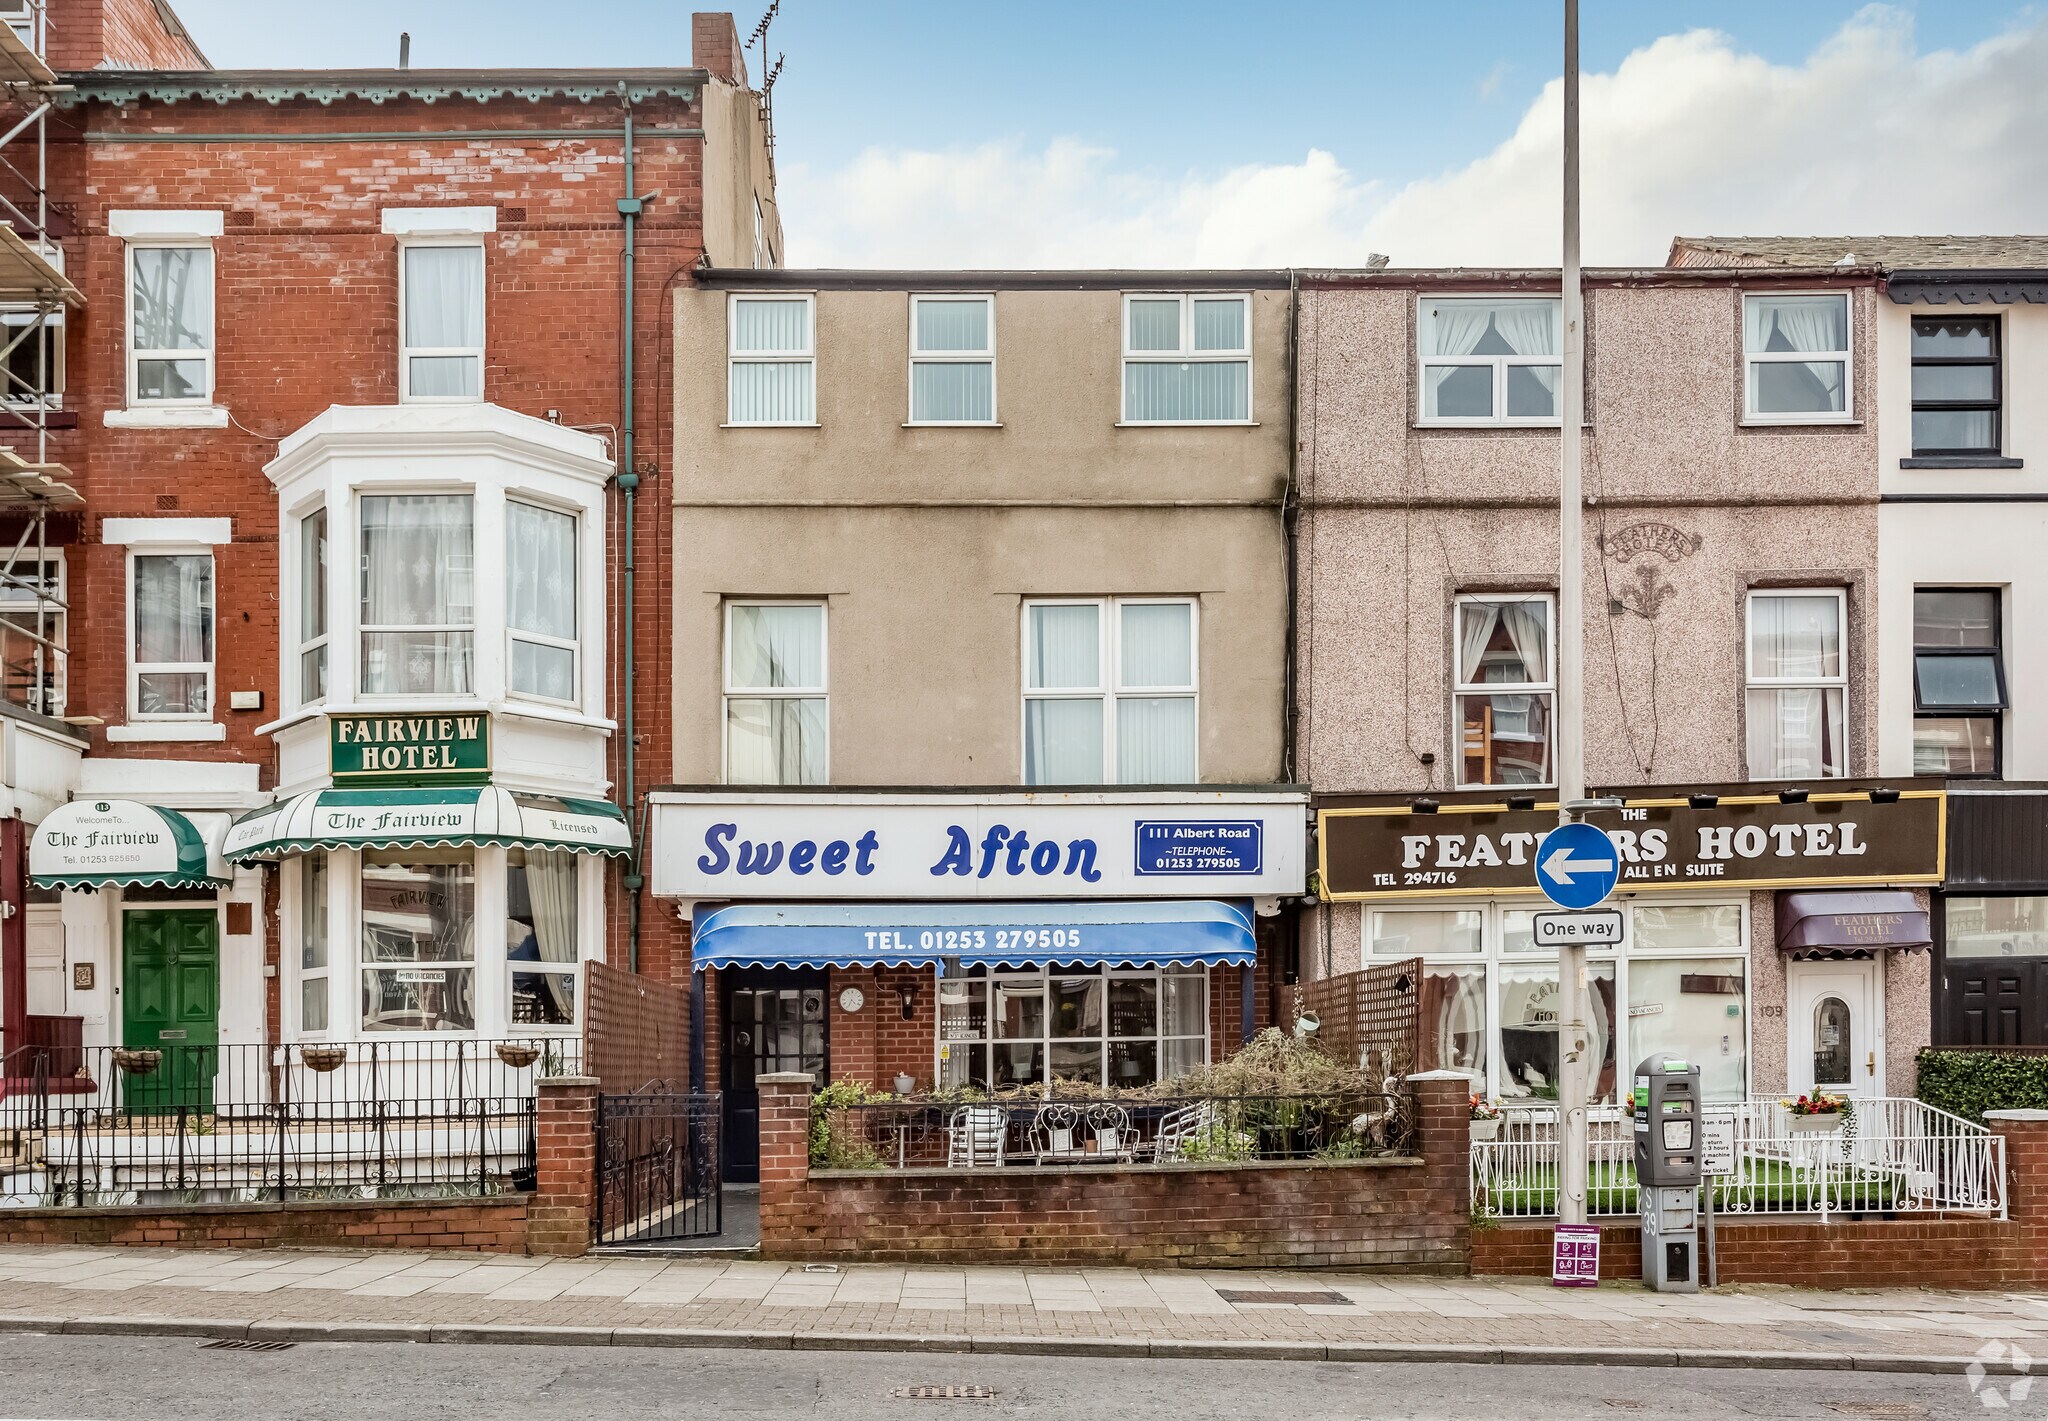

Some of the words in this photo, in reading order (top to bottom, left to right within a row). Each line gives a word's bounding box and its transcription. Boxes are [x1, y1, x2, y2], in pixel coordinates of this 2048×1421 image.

[338, 717, 480, 743] FAIRVIEW
[361, 745, 457, 770] HOTEL
[328, 813, 366, 831] The
[371, 811, 462, 831] Fairview
[1621, 808, 1647, 821] THE
[549, 819, 598, 835] Licensed
[1149, 828, 1168, 838] 111
[1173, 828, 1215, 838] Albert
[1218, 828, 1250, 838] Road
[47, 831, 78, 849] The
[84, 830, 159, 849] Fairview
[1400, 828, 1669, 869] FEATRS
[1697, 822, 1868, 860] HOTEL
[63, 855, 78, 864] Tel.
[80, 855, 107, 864] 01253
[109, 854, 141, 862] 625650
[697, 822, 880, 877] Sweet
[929, 823, 1102, 884] Afton
[1156, 858, 1193, 868] 01253
[1196, 858, 1241, 868] 279505
[1624, 866, 1650, 878] ALL
[1686, 863, 1724, 876] SUITE
[1373, 873, 1397, 886] TEL
[1404, 872, 1457, 885] 294716
[390, 890, 448, 910] FAIRVIEW
[1834, 914, 1903, 926] FEATHERS
[1543, 922, 1576, 936] One
[1582, 923, 1614, 937] way
[1846, 925, 1894, 936] HOTEL
[396, 940, 441, 954] HOTEL
[864, 930, 914, 951] TEL.
[920, 930, 986, 950] 01253
[995, 929, 1081, 949] 279505
[405, 972, 414, 980] NO
[1760, 1005, 1783, 1017] 109
[1645, 1186, 1653, 1209] S
[1643, 1211, 1657, 1237] 39
